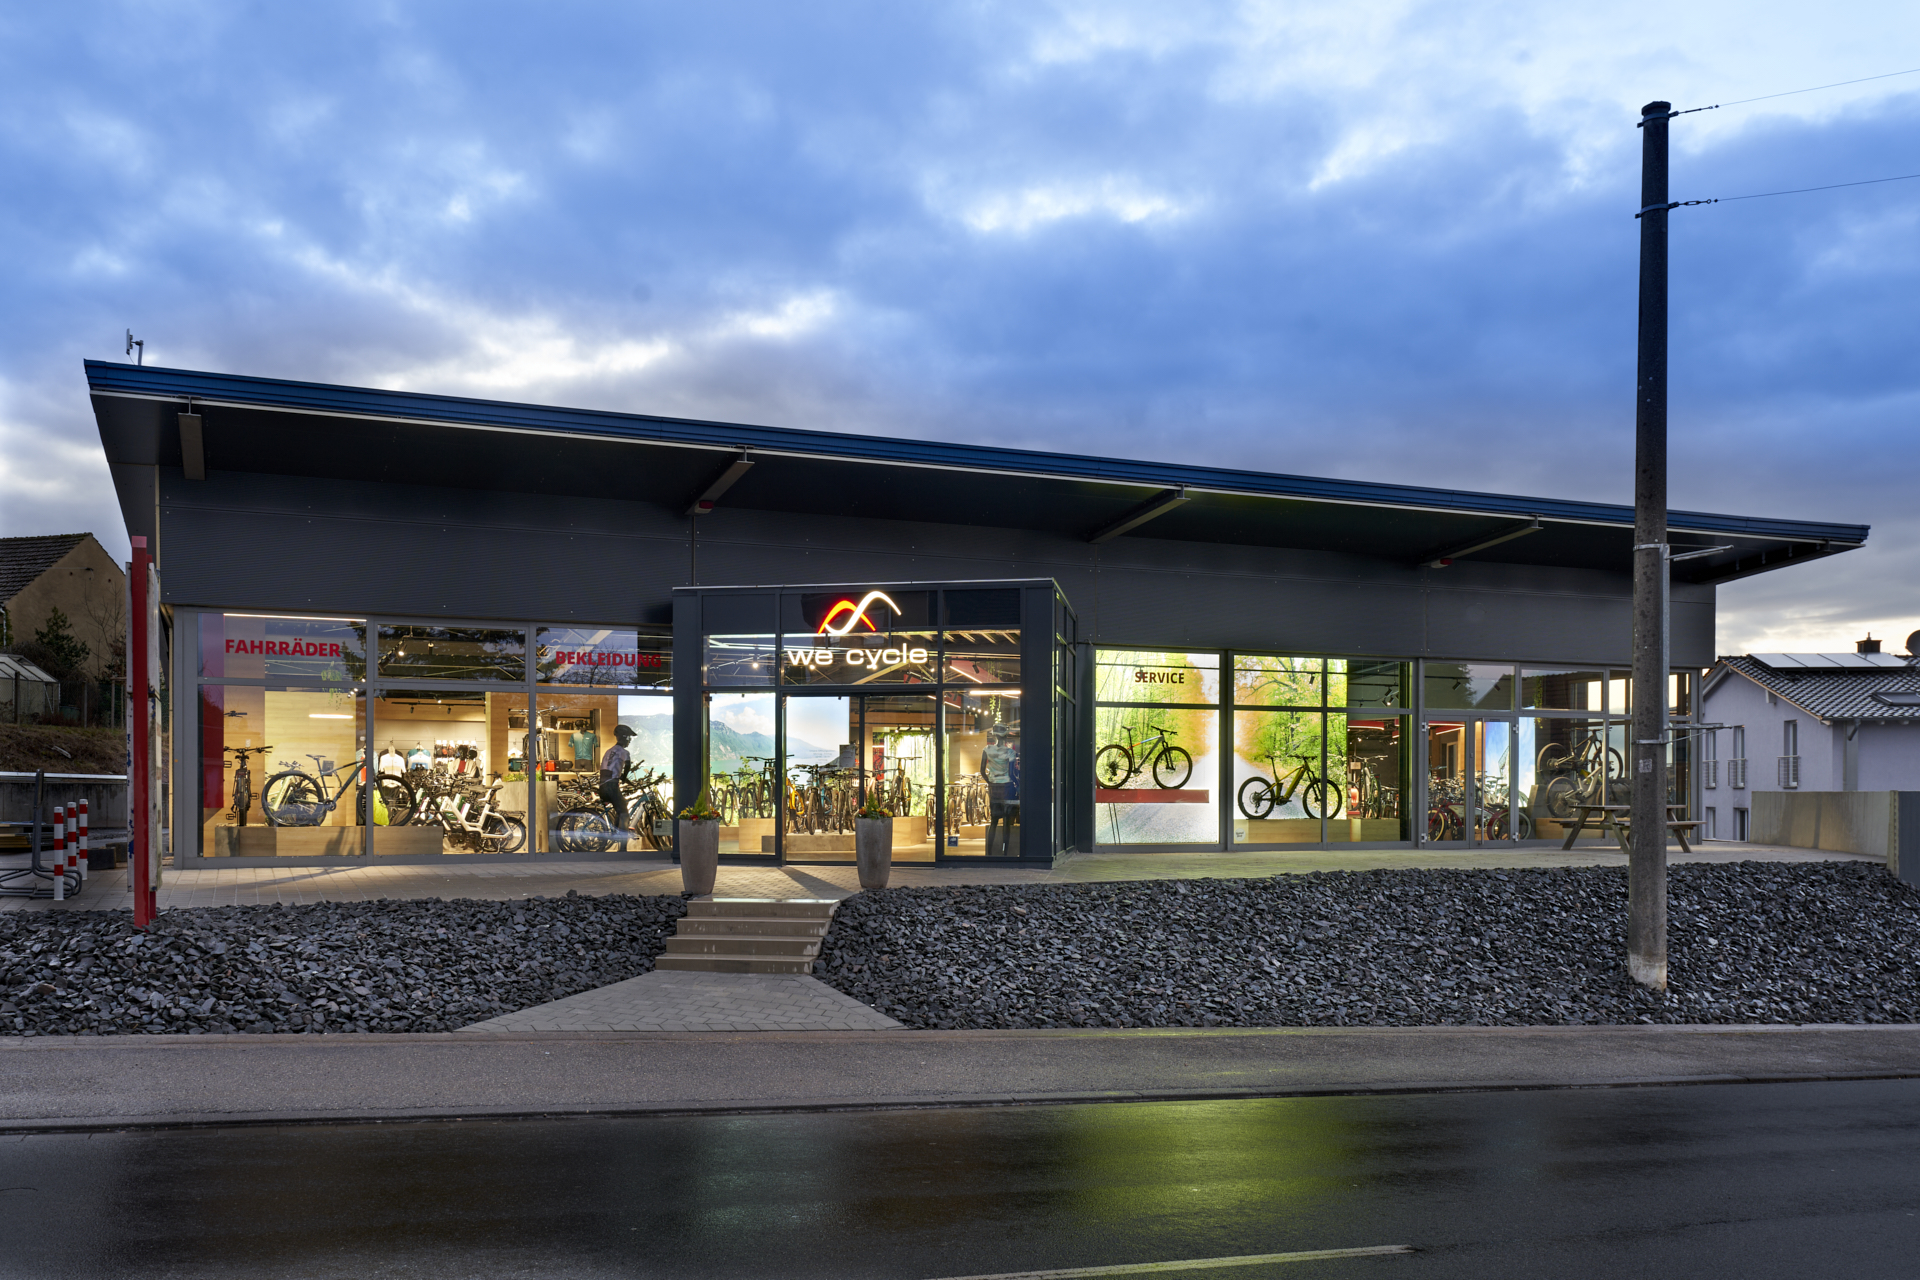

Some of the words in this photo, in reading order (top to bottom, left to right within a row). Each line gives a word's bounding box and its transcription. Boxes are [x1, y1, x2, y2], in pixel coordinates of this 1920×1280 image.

[225, 638, 341, 657] FAHRRÄDER
[787, 649, 833, 665] we
[846, 643, 928, 669] cycle
[555, 651, 662, 667] BEKLEIDUNG
[1135, 671, 1185, 684] SERVICE
